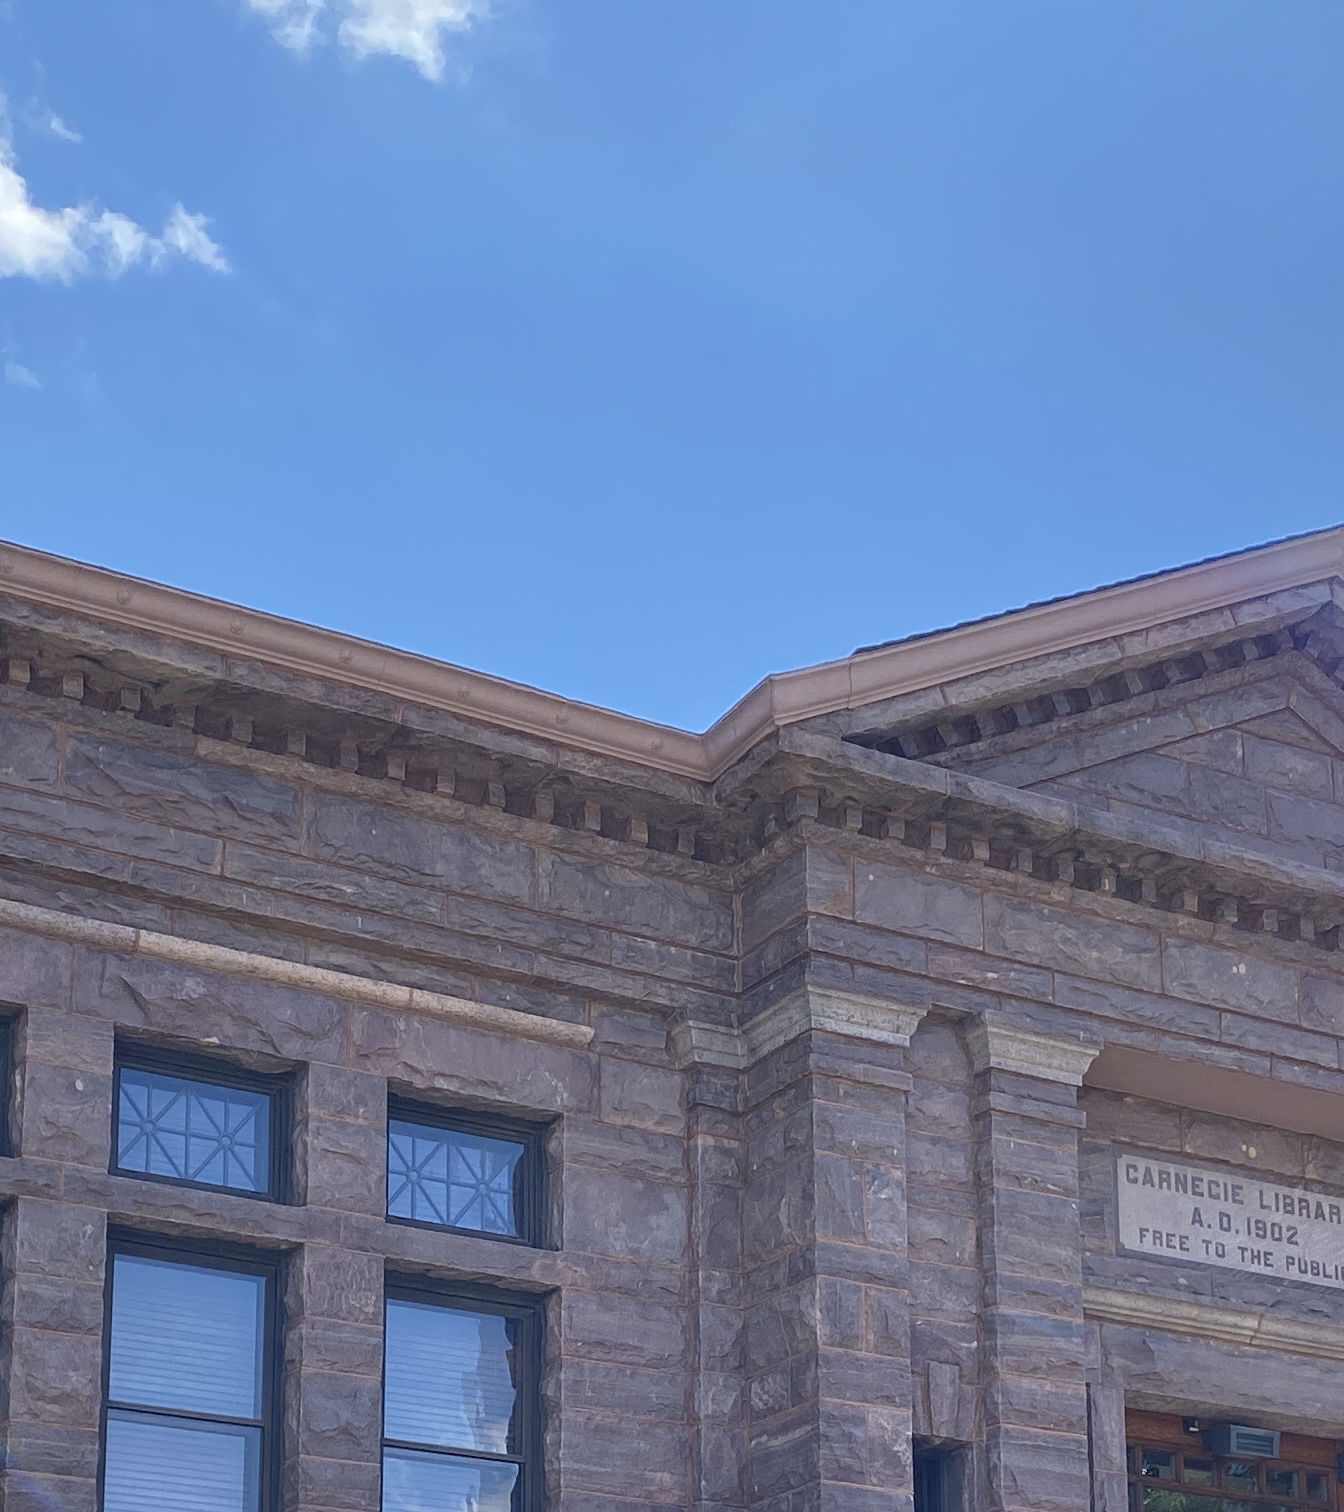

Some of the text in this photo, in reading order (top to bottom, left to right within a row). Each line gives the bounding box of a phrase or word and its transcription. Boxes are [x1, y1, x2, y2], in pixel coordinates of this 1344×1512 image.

[1138, 1226, 1190, 1252] FREE
[1201, 1238, 1226, 1259] TO
[1237, 1245, 1274, 1268] THE
